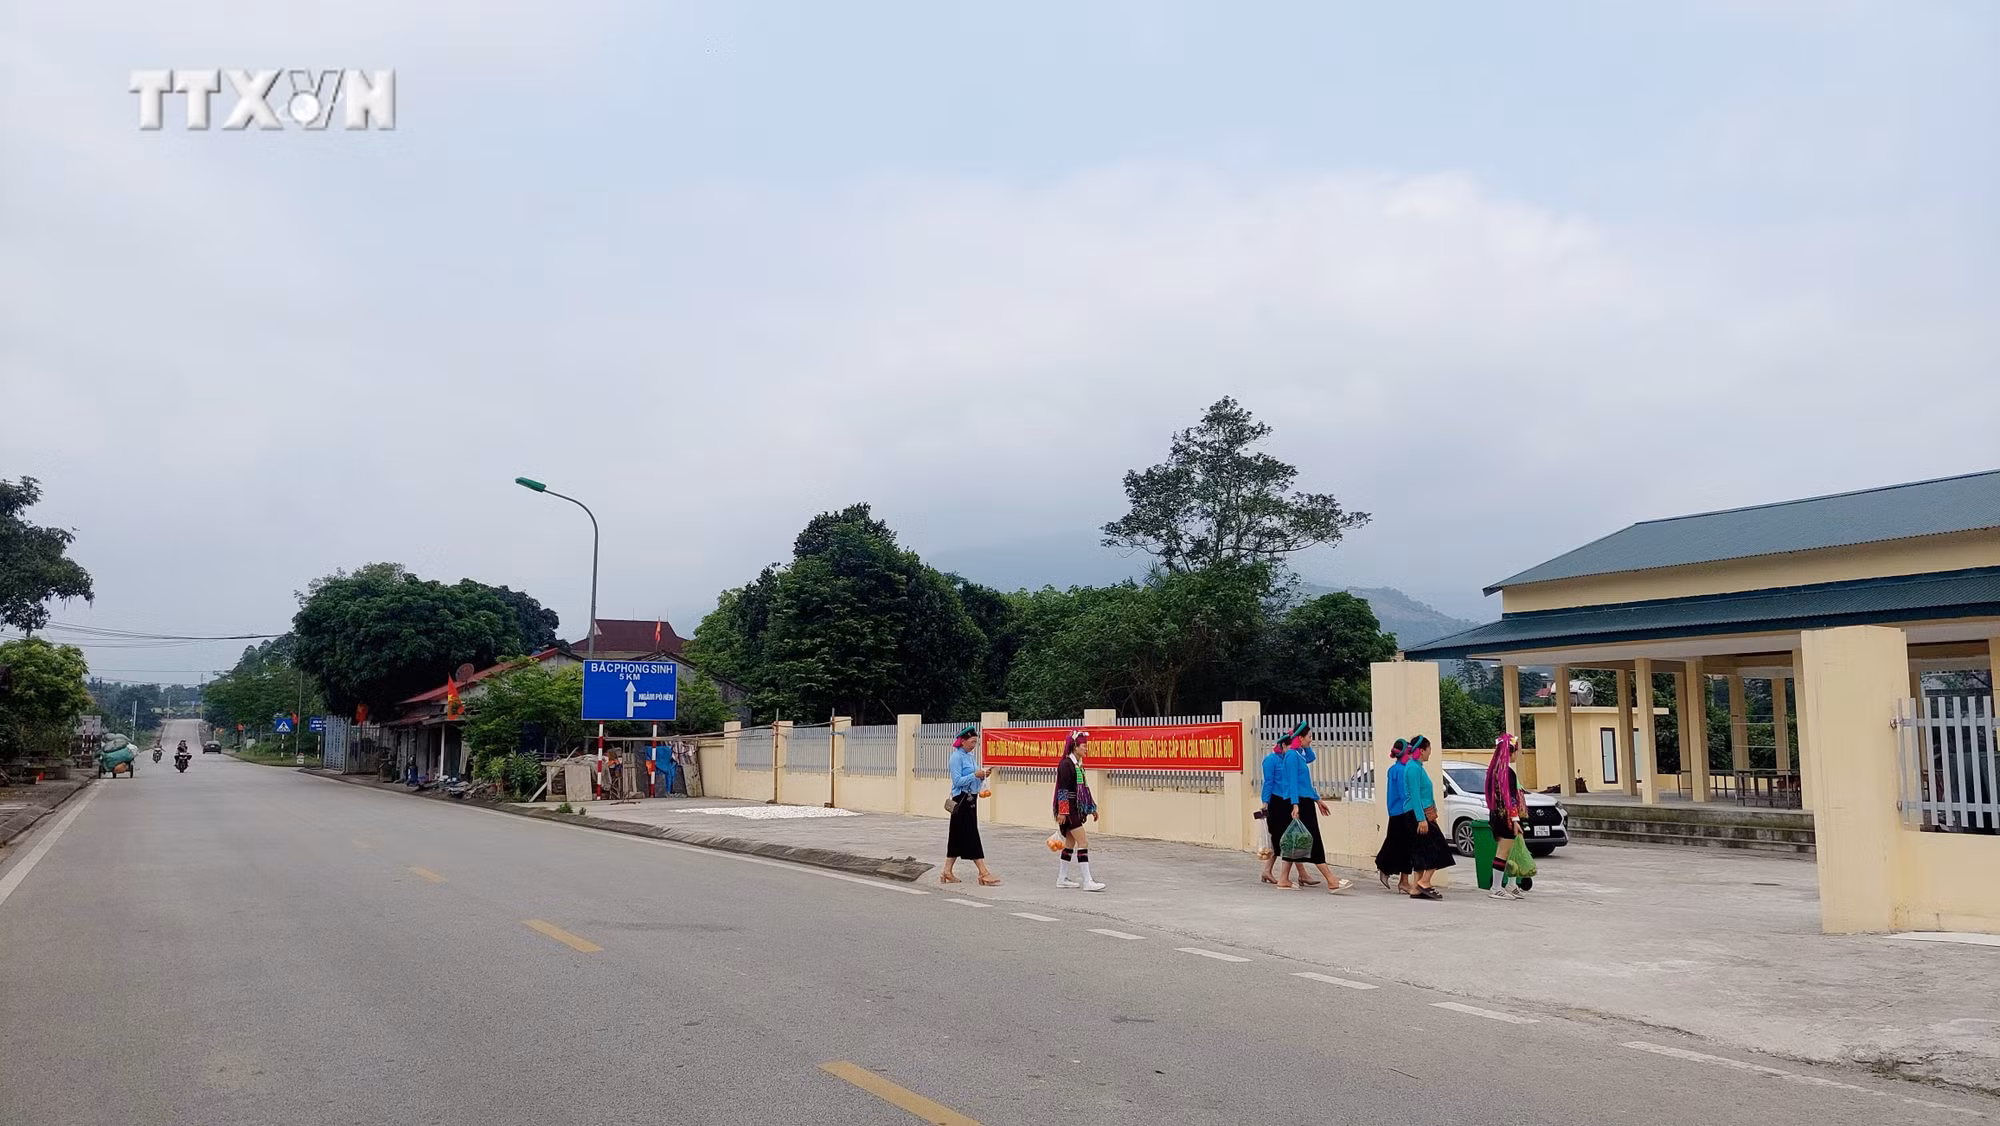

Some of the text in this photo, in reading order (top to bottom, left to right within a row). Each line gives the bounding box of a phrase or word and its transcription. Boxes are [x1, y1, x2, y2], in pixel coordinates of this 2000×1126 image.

[614, 663, 649, 673] PHONG
[650, 664, 673, 675] SINH
[619, 673, 641, 681] 5 KM
